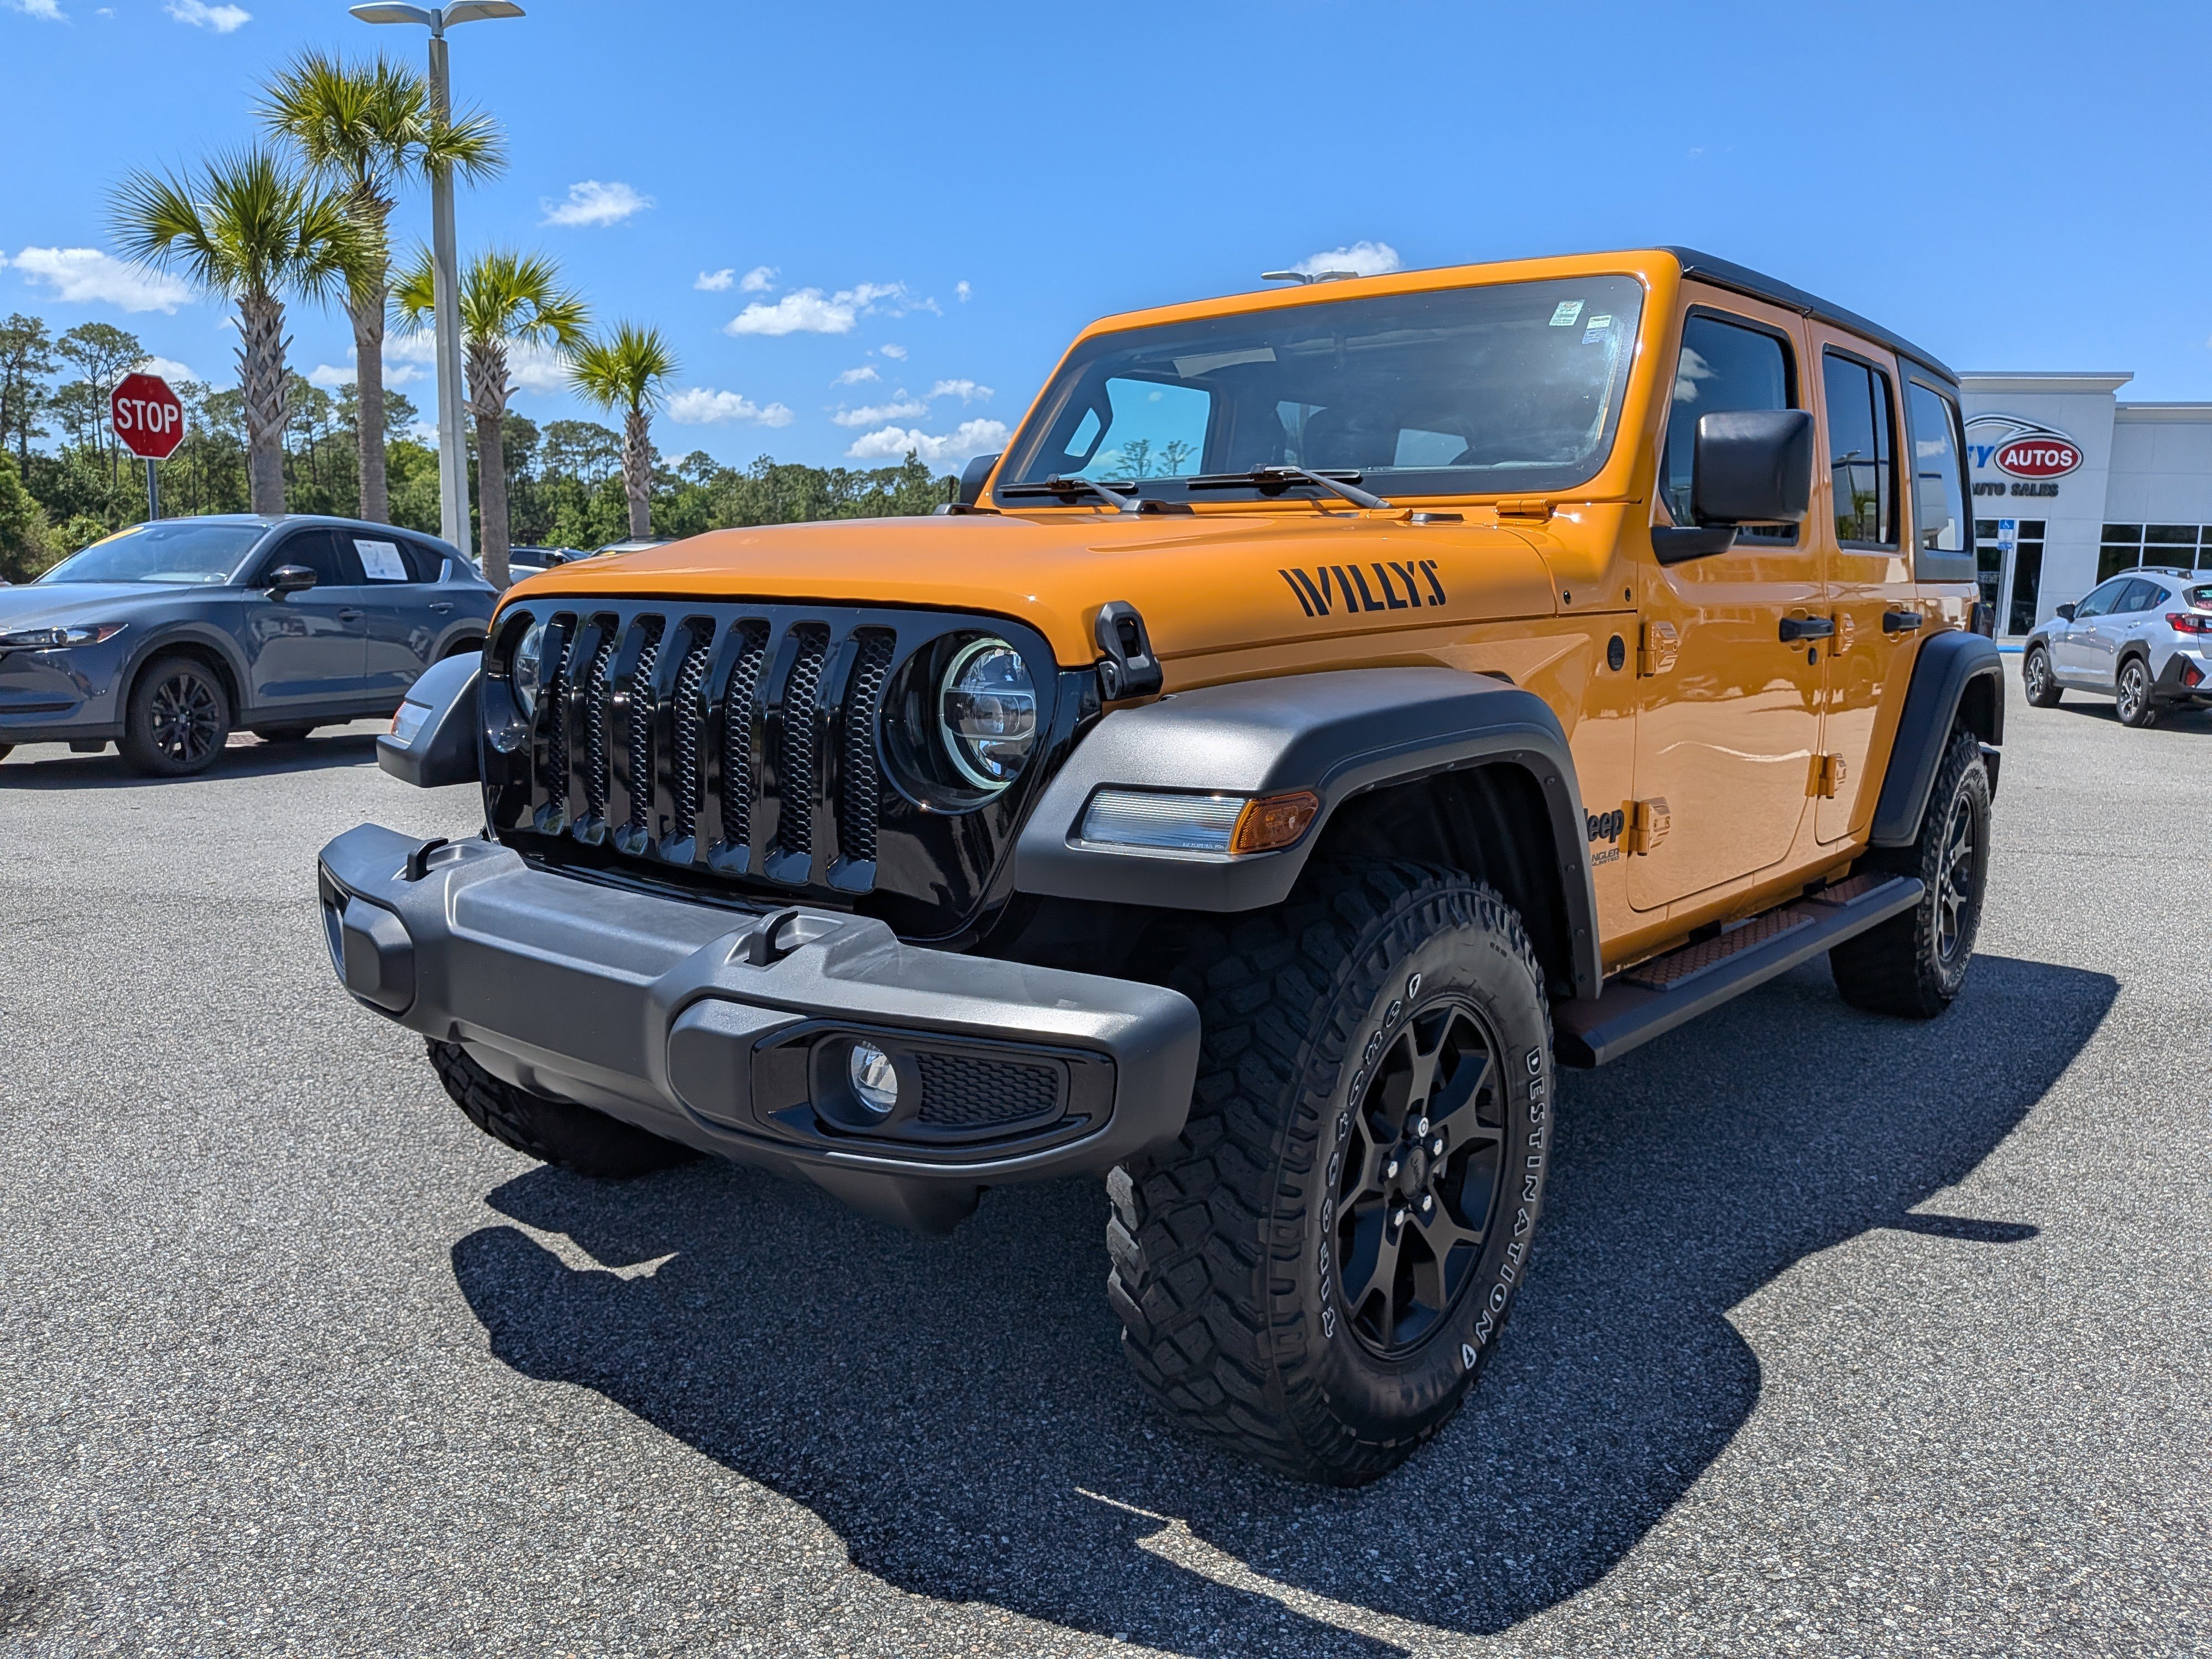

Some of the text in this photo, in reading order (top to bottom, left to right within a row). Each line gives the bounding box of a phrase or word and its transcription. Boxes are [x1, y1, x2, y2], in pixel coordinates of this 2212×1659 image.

[117, 398, 178, 434] STOP
[2005, 450, 2073, 467] AUTOS
[2011, 482, 2059, 497] SALES
[1277, 560, 1447, 617] WILLYS
[1475, 1046, 1545, 1345] DESTINATION
